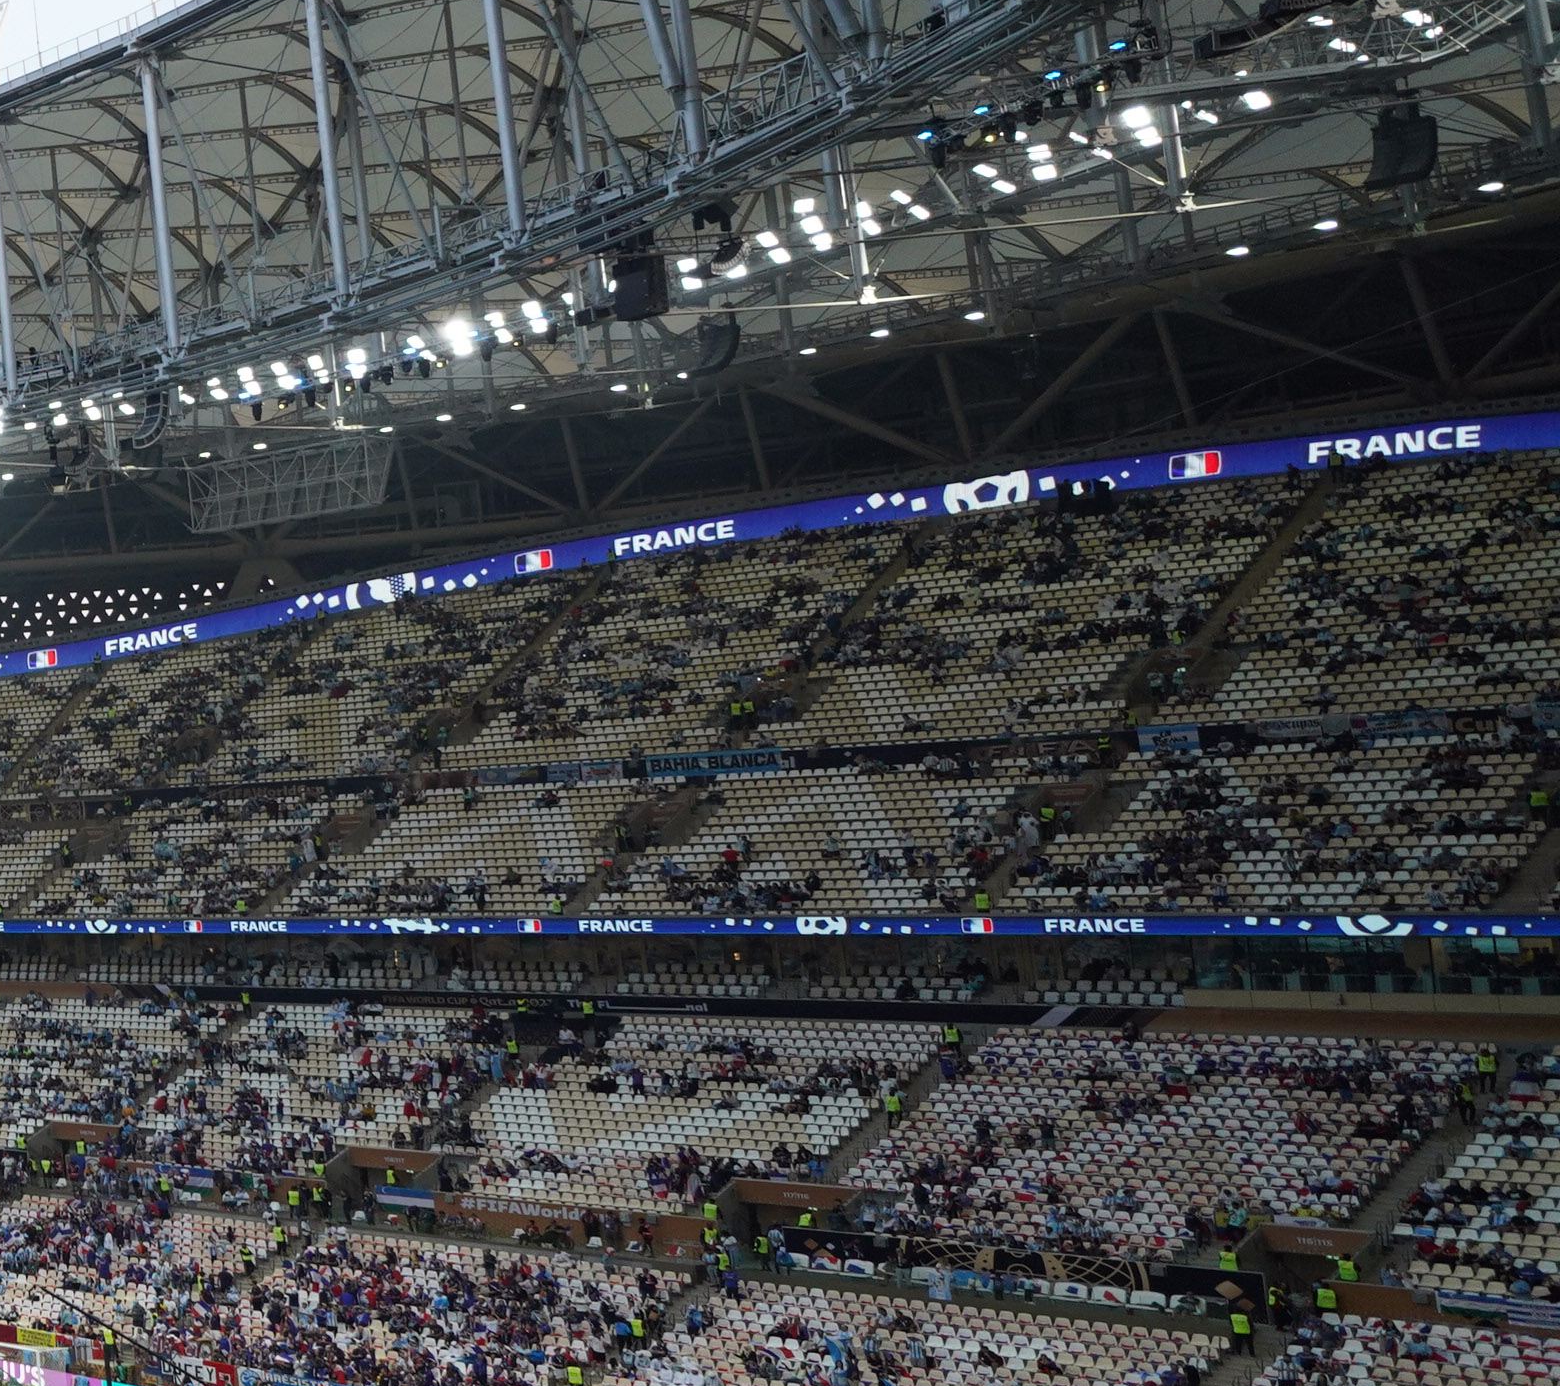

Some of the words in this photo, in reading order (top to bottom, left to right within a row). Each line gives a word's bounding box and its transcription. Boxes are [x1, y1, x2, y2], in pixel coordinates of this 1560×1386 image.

[1309, 425, 1480, 463] FRANCE
[614, 520, 735, 556] FRANCE
[105, 623, 197, 655] FRANCE
[651, 756, 699, 773] BAHIA
[709, 752, 777, 769] BLANCA
[231, 921, 287, 931] FRANCE
[579, 920, 653, 932] FRANCE
[1045, 919, 1145, 932] FRANCE
